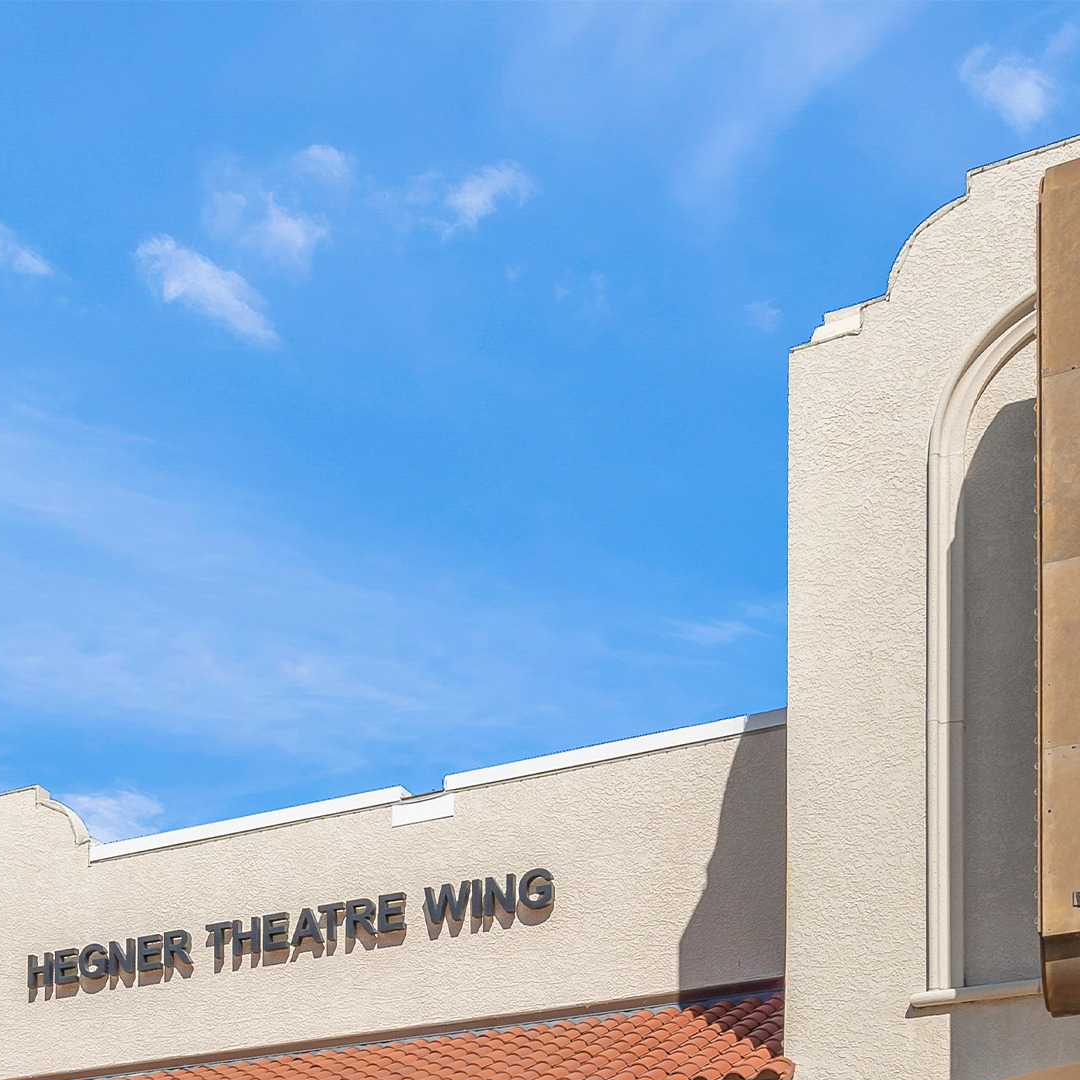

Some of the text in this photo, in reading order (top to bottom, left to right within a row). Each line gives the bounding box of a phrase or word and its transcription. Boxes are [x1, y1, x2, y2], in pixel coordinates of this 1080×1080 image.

[27, 867, 556, 989] HEGNER THEATRE WING
